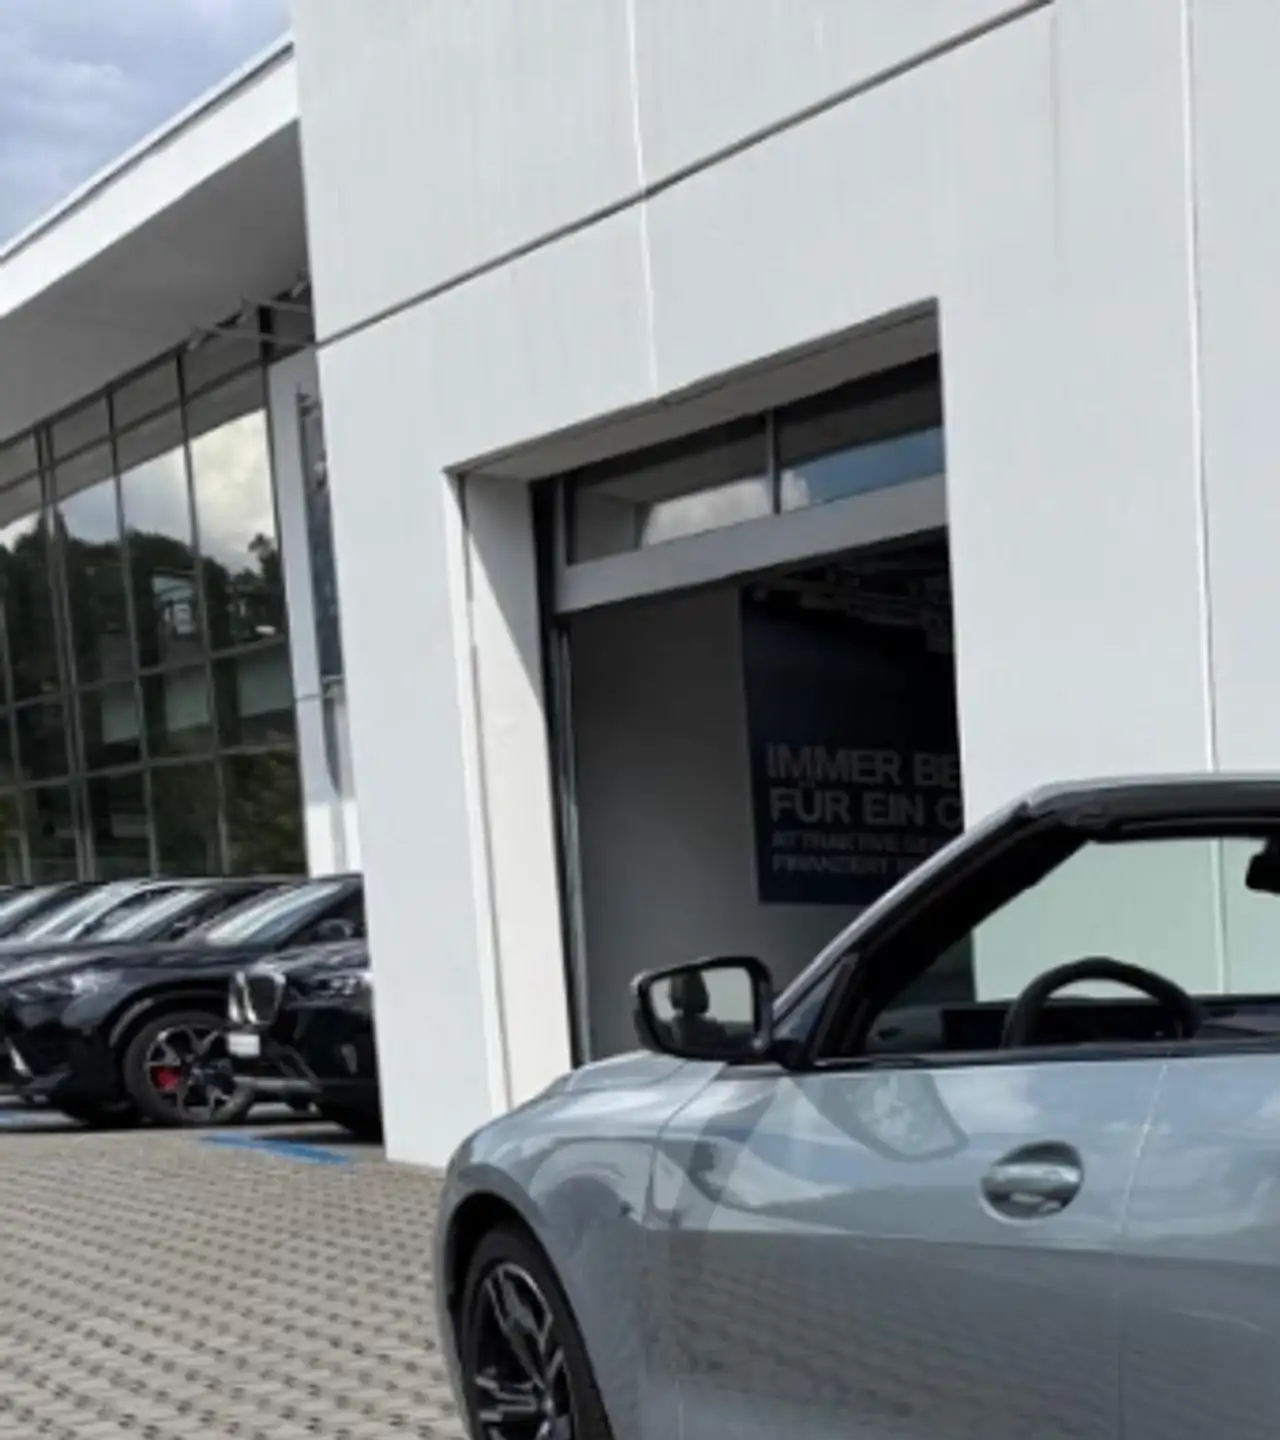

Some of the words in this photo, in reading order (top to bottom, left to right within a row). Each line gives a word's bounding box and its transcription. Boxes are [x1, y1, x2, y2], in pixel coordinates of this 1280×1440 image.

[766, 742, 903, 785] IMMER
[770, 781, 851, 825] FÜR
[863, 792, 925, 828] EIN
